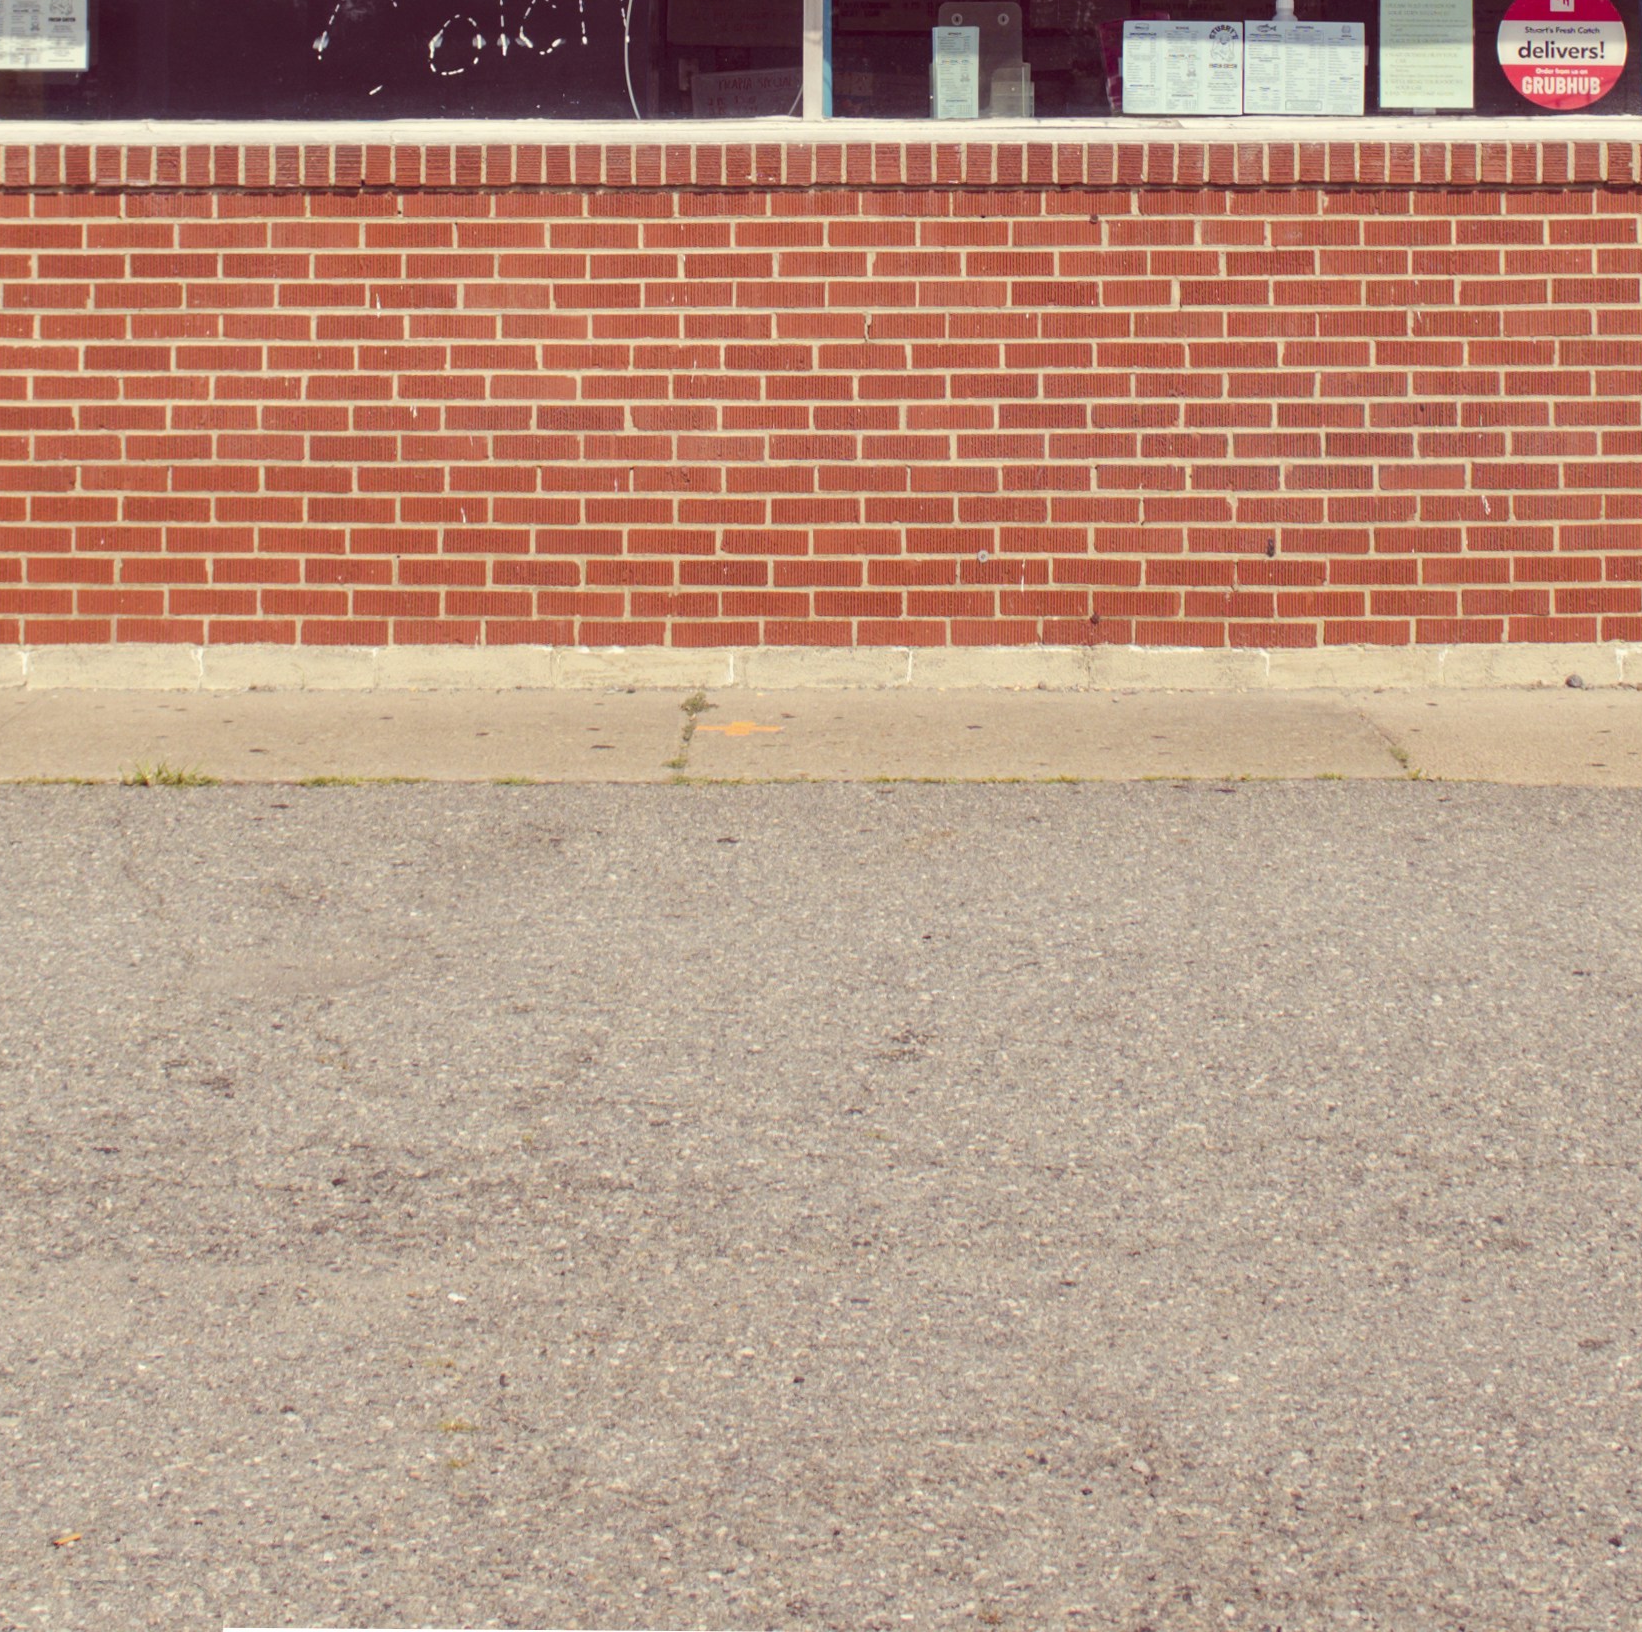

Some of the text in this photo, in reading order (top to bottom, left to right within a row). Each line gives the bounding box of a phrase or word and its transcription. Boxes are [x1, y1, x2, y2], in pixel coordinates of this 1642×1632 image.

[1525, 26, 1600, 34] Stuart's Fresh Catch
[1518, 40, 1605, 59] delivers!
[1522, 76, 1601, 95] GRUBHUB
